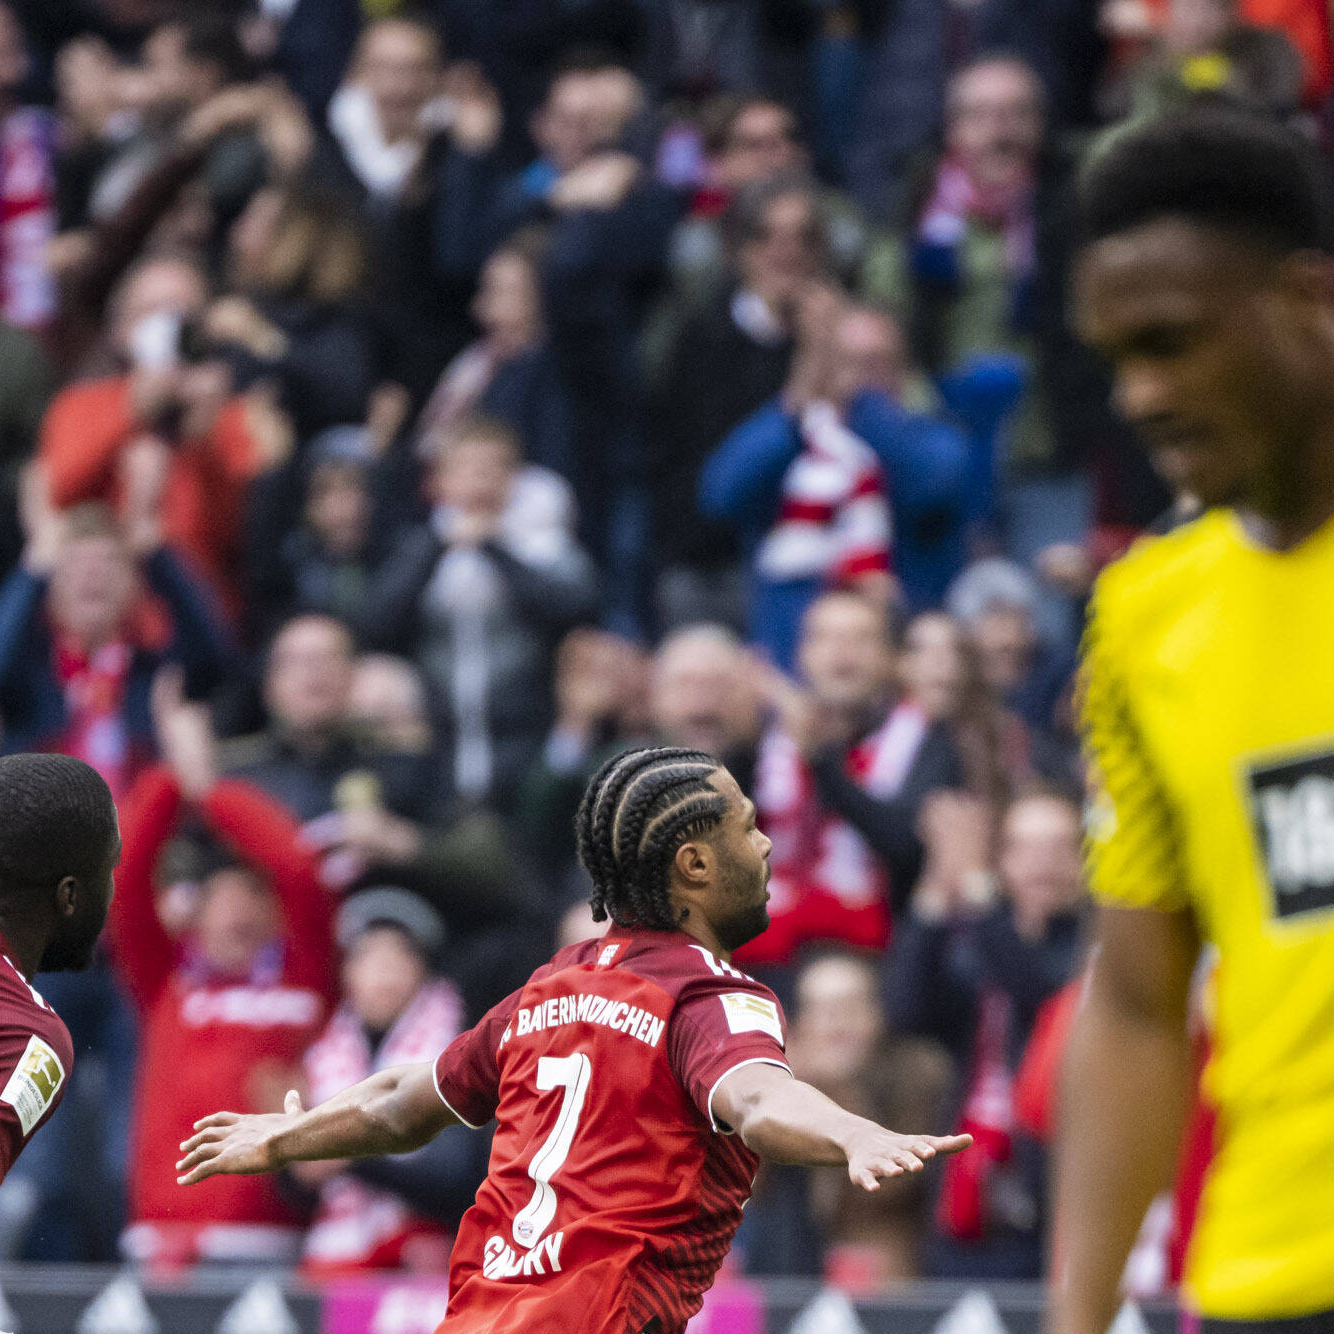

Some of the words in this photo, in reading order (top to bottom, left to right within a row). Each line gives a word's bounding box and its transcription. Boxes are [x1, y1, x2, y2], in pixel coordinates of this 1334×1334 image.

[517, 995, 578, 1037] BAYERN
[576, 993, 665, 1048] MÜNCHEN
[512, 1053, 592, 1249] 7
